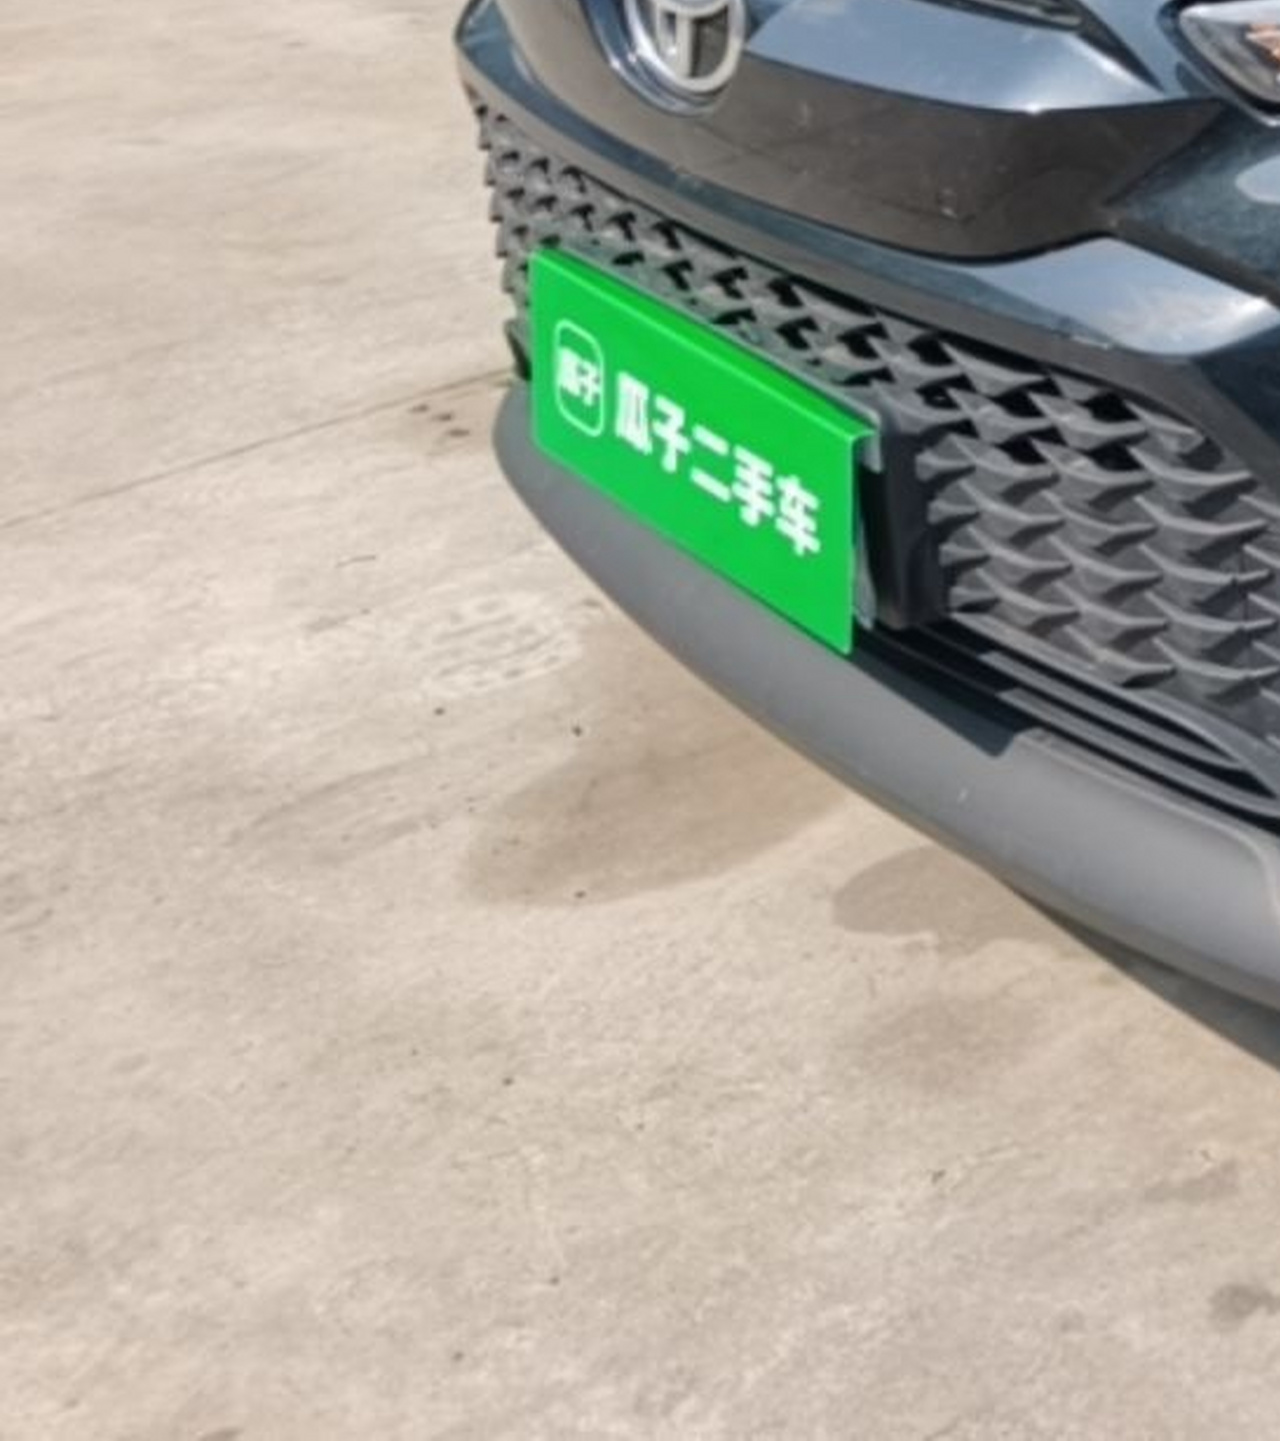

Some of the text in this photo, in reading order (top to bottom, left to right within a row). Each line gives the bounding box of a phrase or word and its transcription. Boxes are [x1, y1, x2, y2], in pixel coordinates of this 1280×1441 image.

[615, 371, 820, 557] 瓜子二手车
